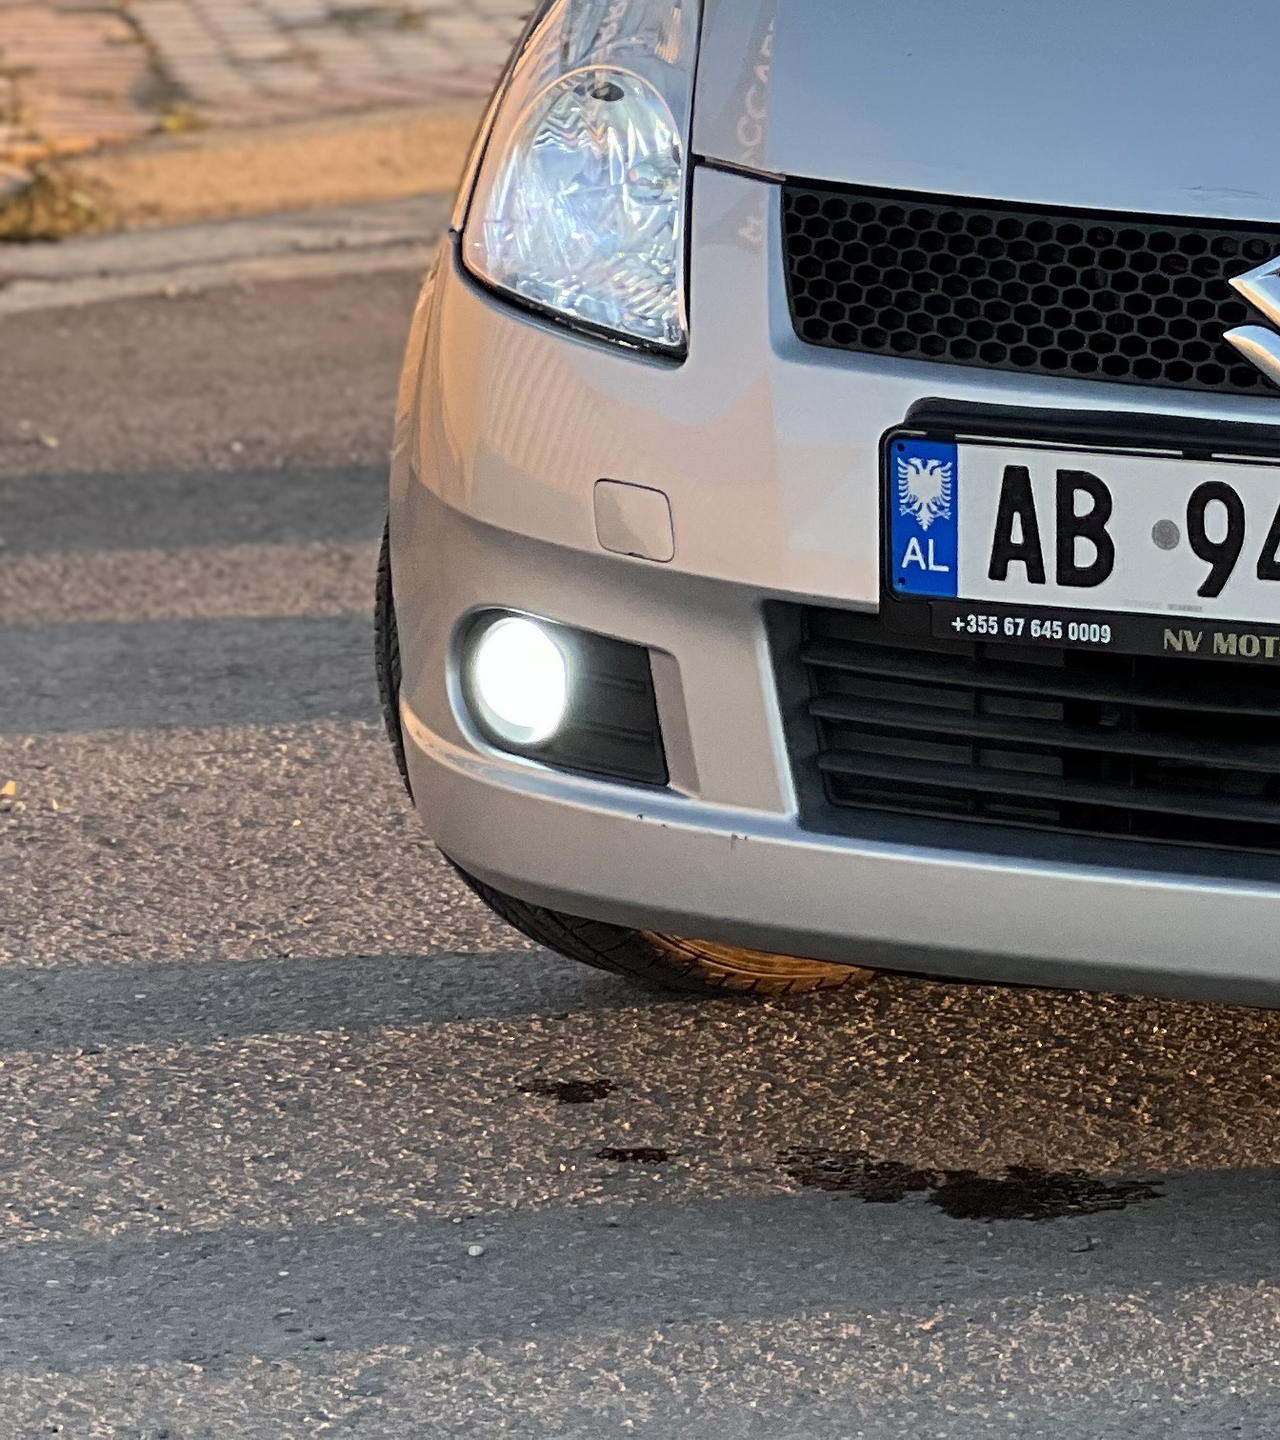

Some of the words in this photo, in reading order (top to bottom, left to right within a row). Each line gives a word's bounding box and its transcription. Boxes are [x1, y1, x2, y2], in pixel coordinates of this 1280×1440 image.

[988, 464, 1115, 588] AB
[901, 536, 949, 572] AL
[951, 615, 999, 634] +355
[1003, 617, 1024, 636] 67
[1030, 619, 1063, 640] 645
[1068, 621, 1112, 644] 0009
[1163, 628, 1203, 653] NV
